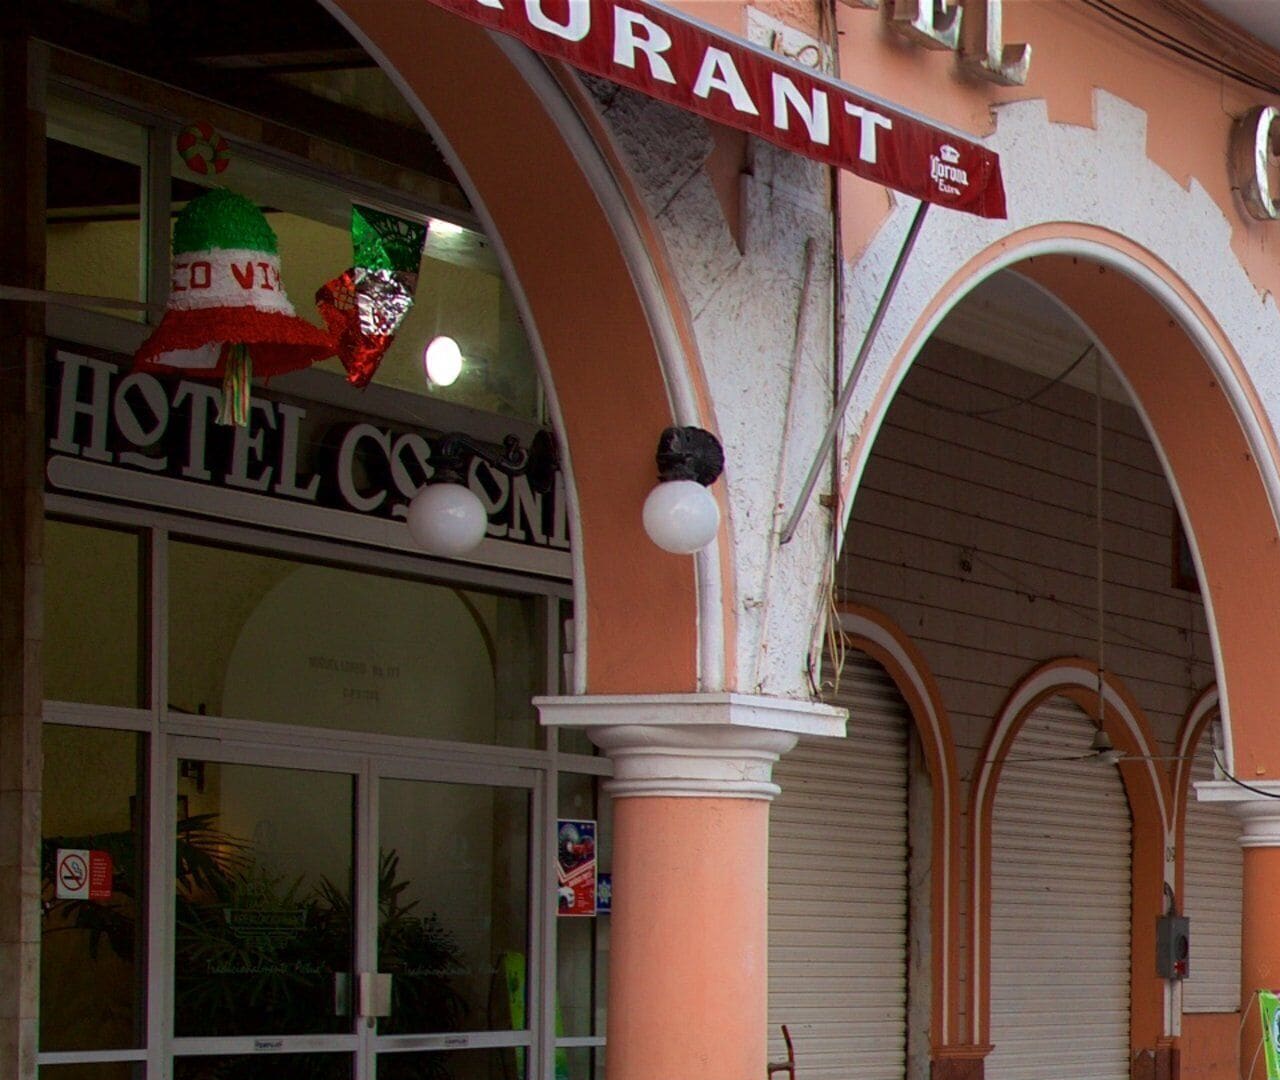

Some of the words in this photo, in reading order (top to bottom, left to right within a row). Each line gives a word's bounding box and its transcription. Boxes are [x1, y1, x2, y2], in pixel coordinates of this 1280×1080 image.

[477, 0, 893, 165] URANT
[930, 154, 969, 186] Corona
[49, 350, 320, 502] HOTEL
